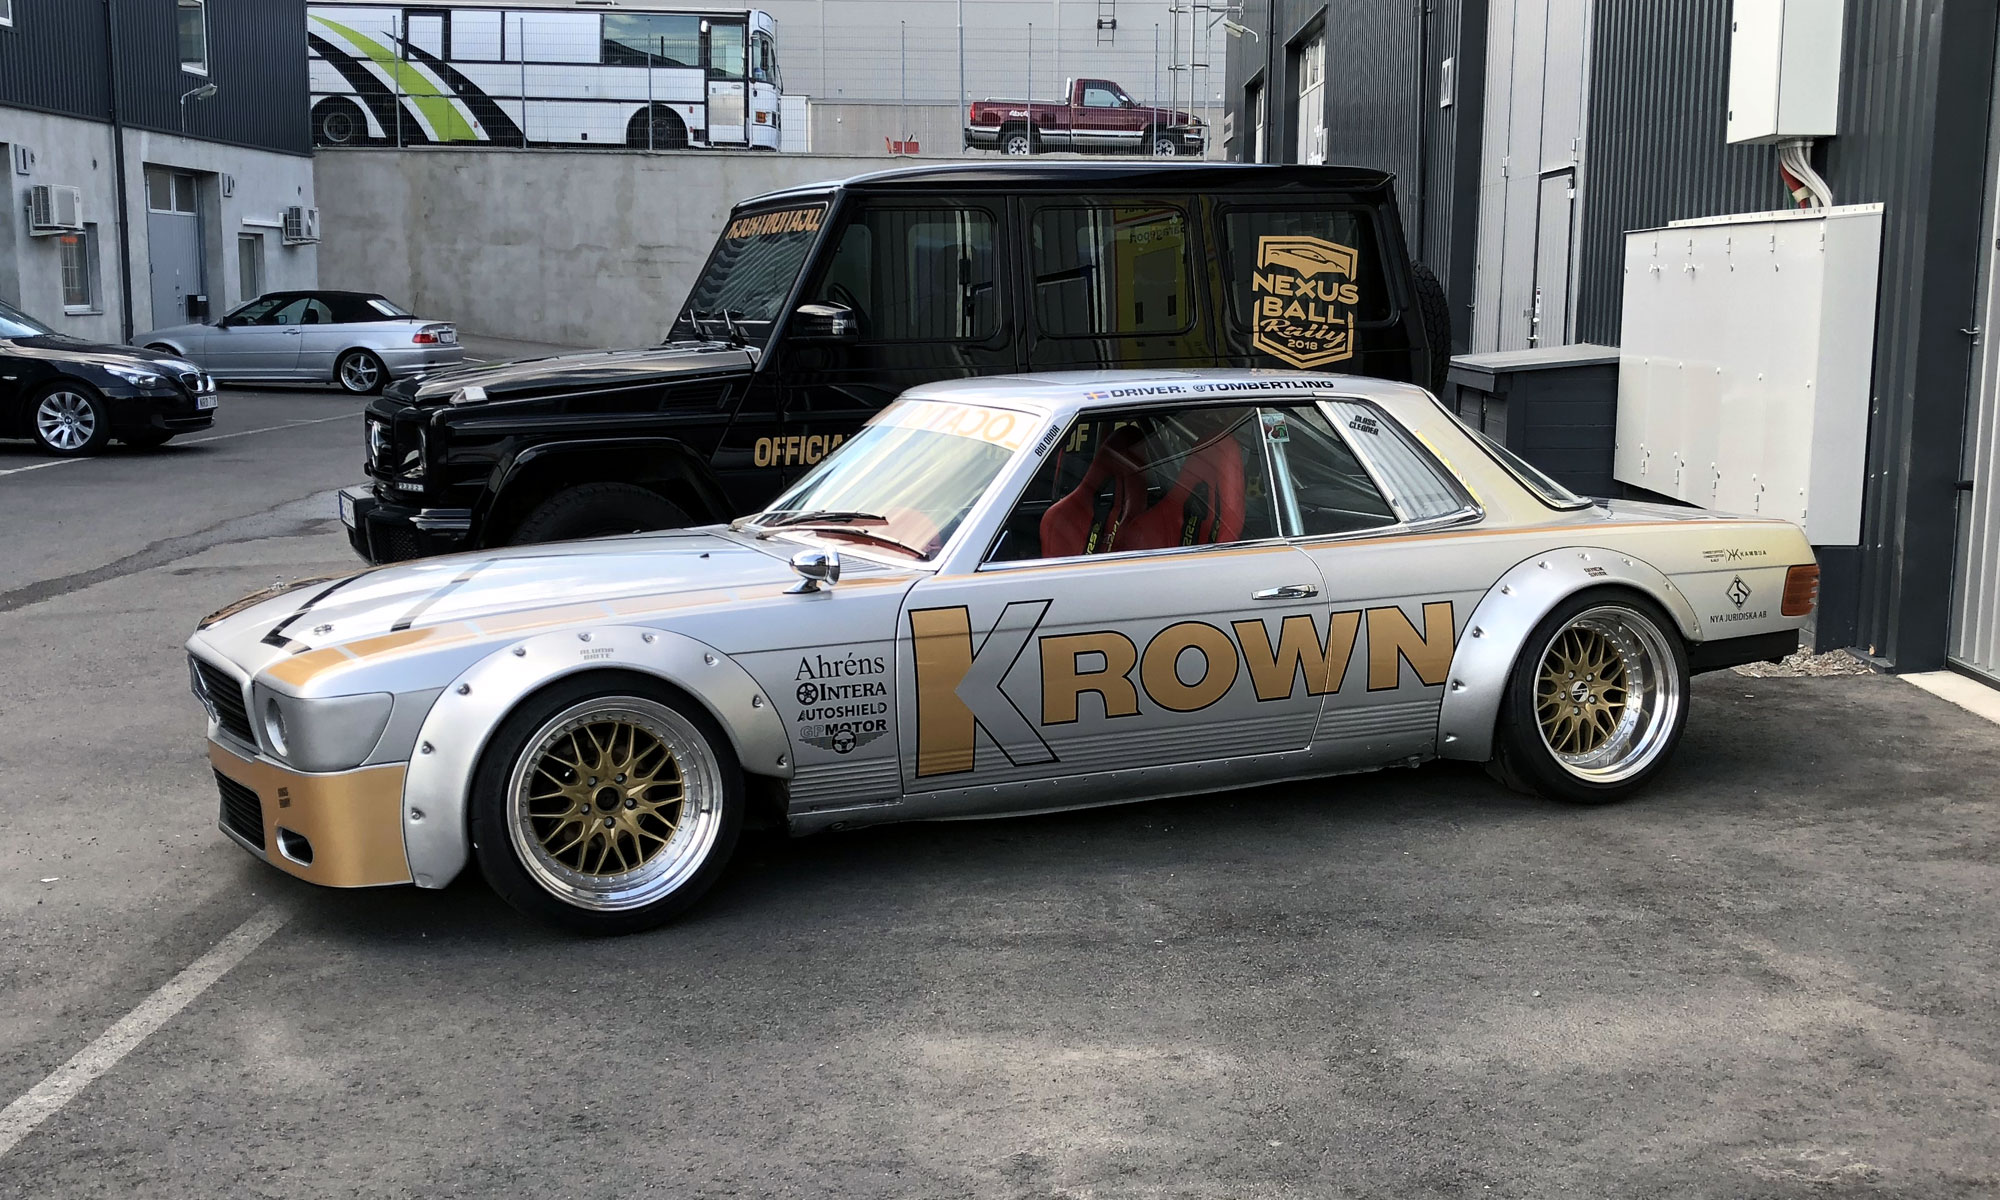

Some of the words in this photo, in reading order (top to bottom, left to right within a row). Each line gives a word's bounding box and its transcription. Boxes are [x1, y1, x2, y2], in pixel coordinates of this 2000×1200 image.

[1252, 271, 1359, 305] NEXUS
[1262, 296, 1345, 324] BALL
[1260, 319, 1346, 348] Rally
[1287, 339, 1318, 350] 2018
[1111, 385, 1187, 399] DRIVER:
[1192, 380, 1335, 393] @TOMBERTLING
[1354, 415, 1377, 427] GLASS
[754, 434, 850, 467] OFFICI
[1034, 442, 1047, 457] BIO
[1043, 424, 1061, 446] ODOR
[1710, 615, 1723, 623] NYA
[1725, 611, 1757, 623] JURIDISKA
[1759, 610, 1767, 619] AB
[794, 652, 885, 681] Ahréns
[820, 682, 887, 701] INTERA
[907, 599, 1455, 779] KROWN
[797, 702, 887, 722] AUTOSHIELD
